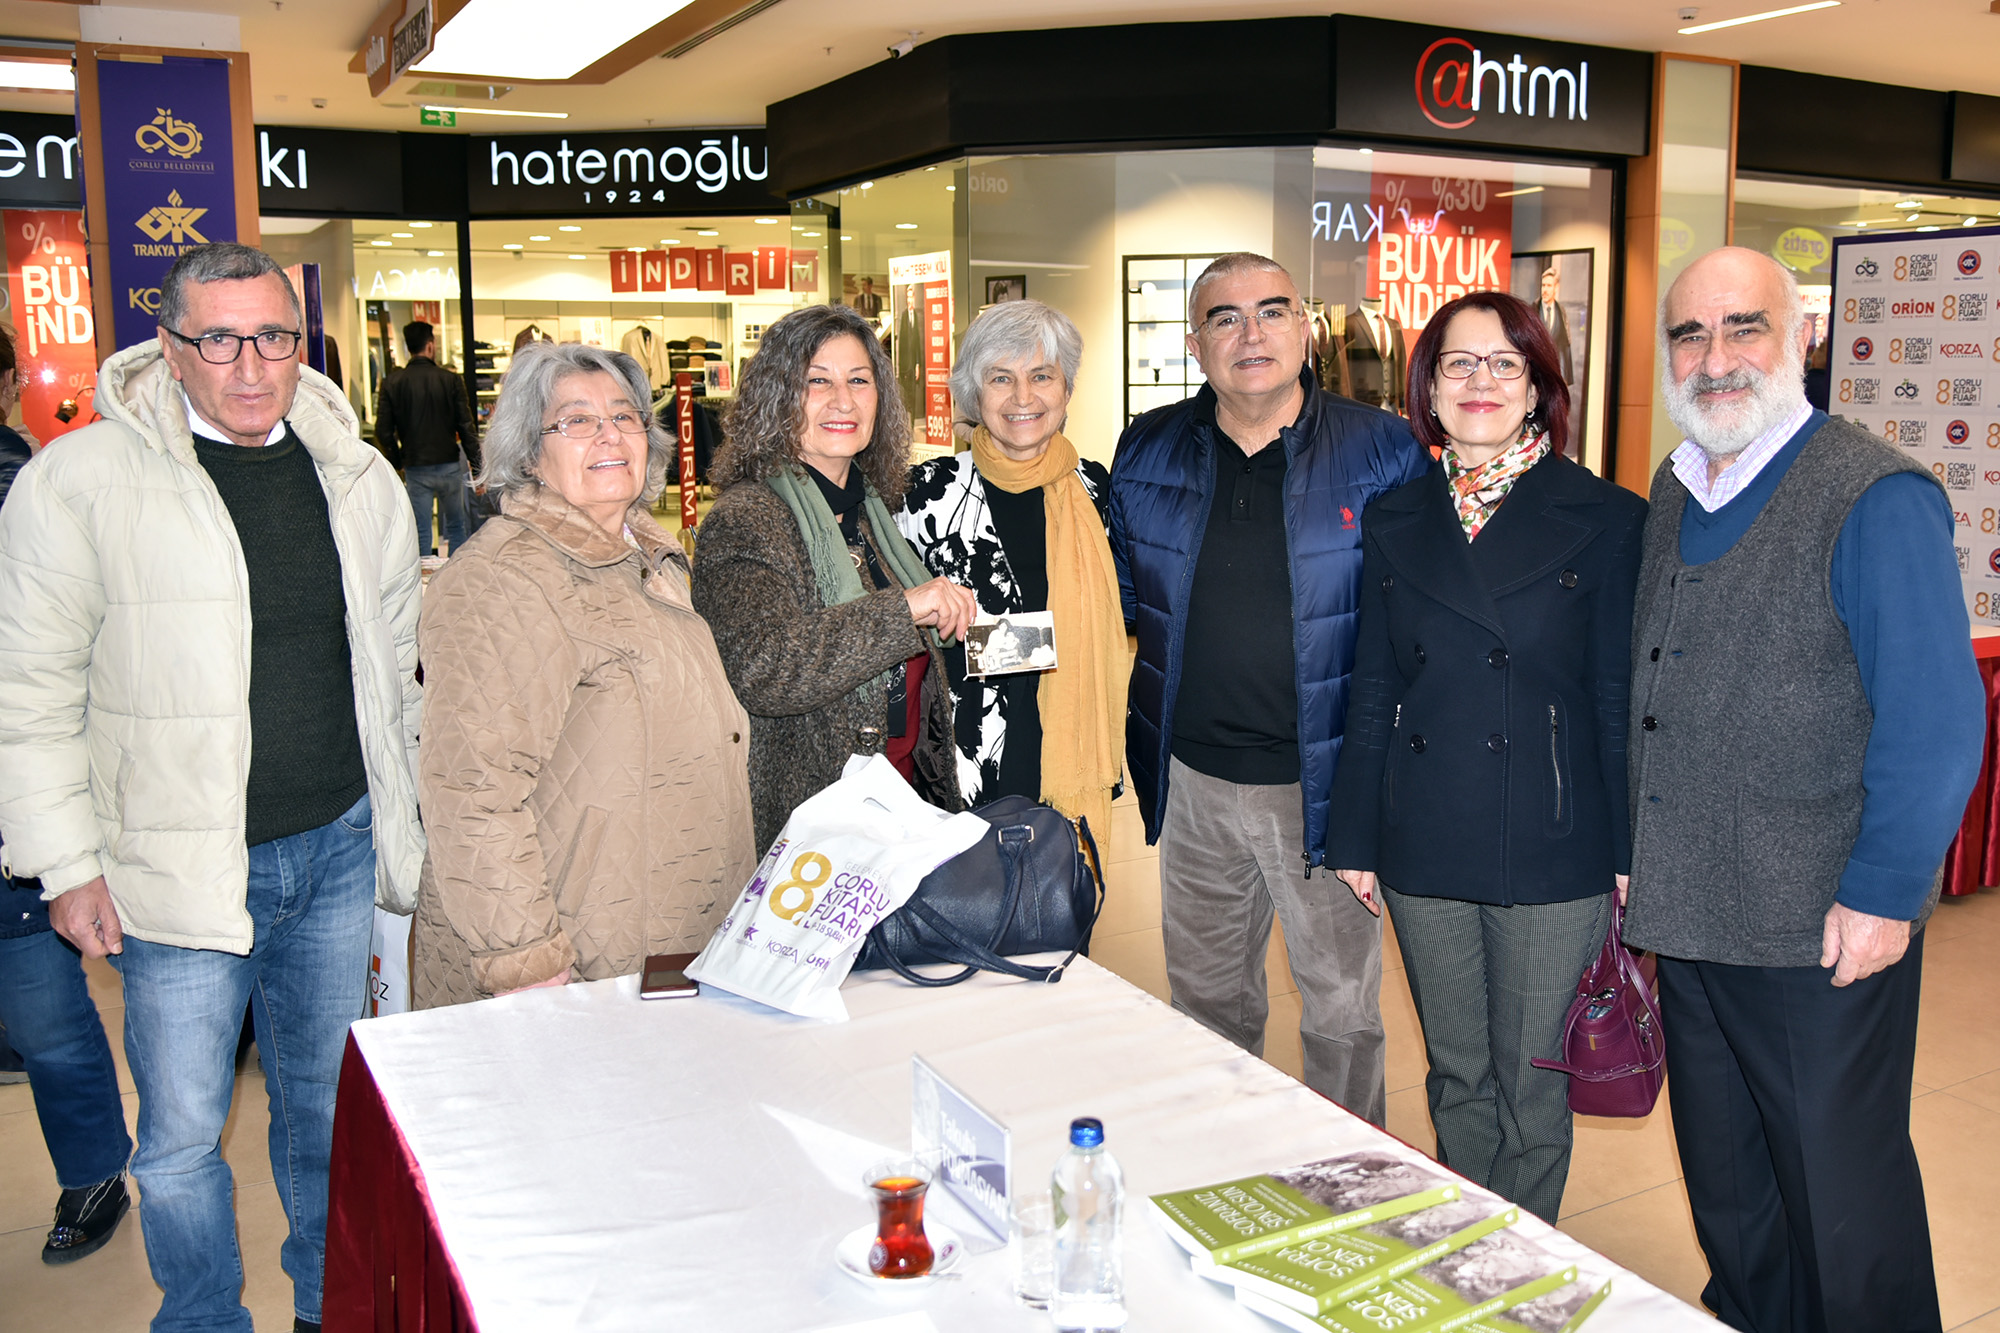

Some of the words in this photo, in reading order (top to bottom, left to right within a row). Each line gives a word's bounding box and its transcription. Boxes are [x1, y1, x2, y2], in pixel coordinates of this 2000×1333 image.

[129, 160, 161, 171] ÇORLU
[164, 159, 215, 172] BELEDİYESİ
[584, 189, 666, 204] 1924
[133, 244, 177, 257] TRAKYA
[1379, 225, 1502, 286] BÜYÜK
[620, 250, 814, 287] İNDİRİM
[1891, 298, 1935, 315] ORİON
[1939, 343, 1983, 358] KORZA
[822, 887, 873, 917] KİTAP
[810, 903, 862, 938] FUARI
